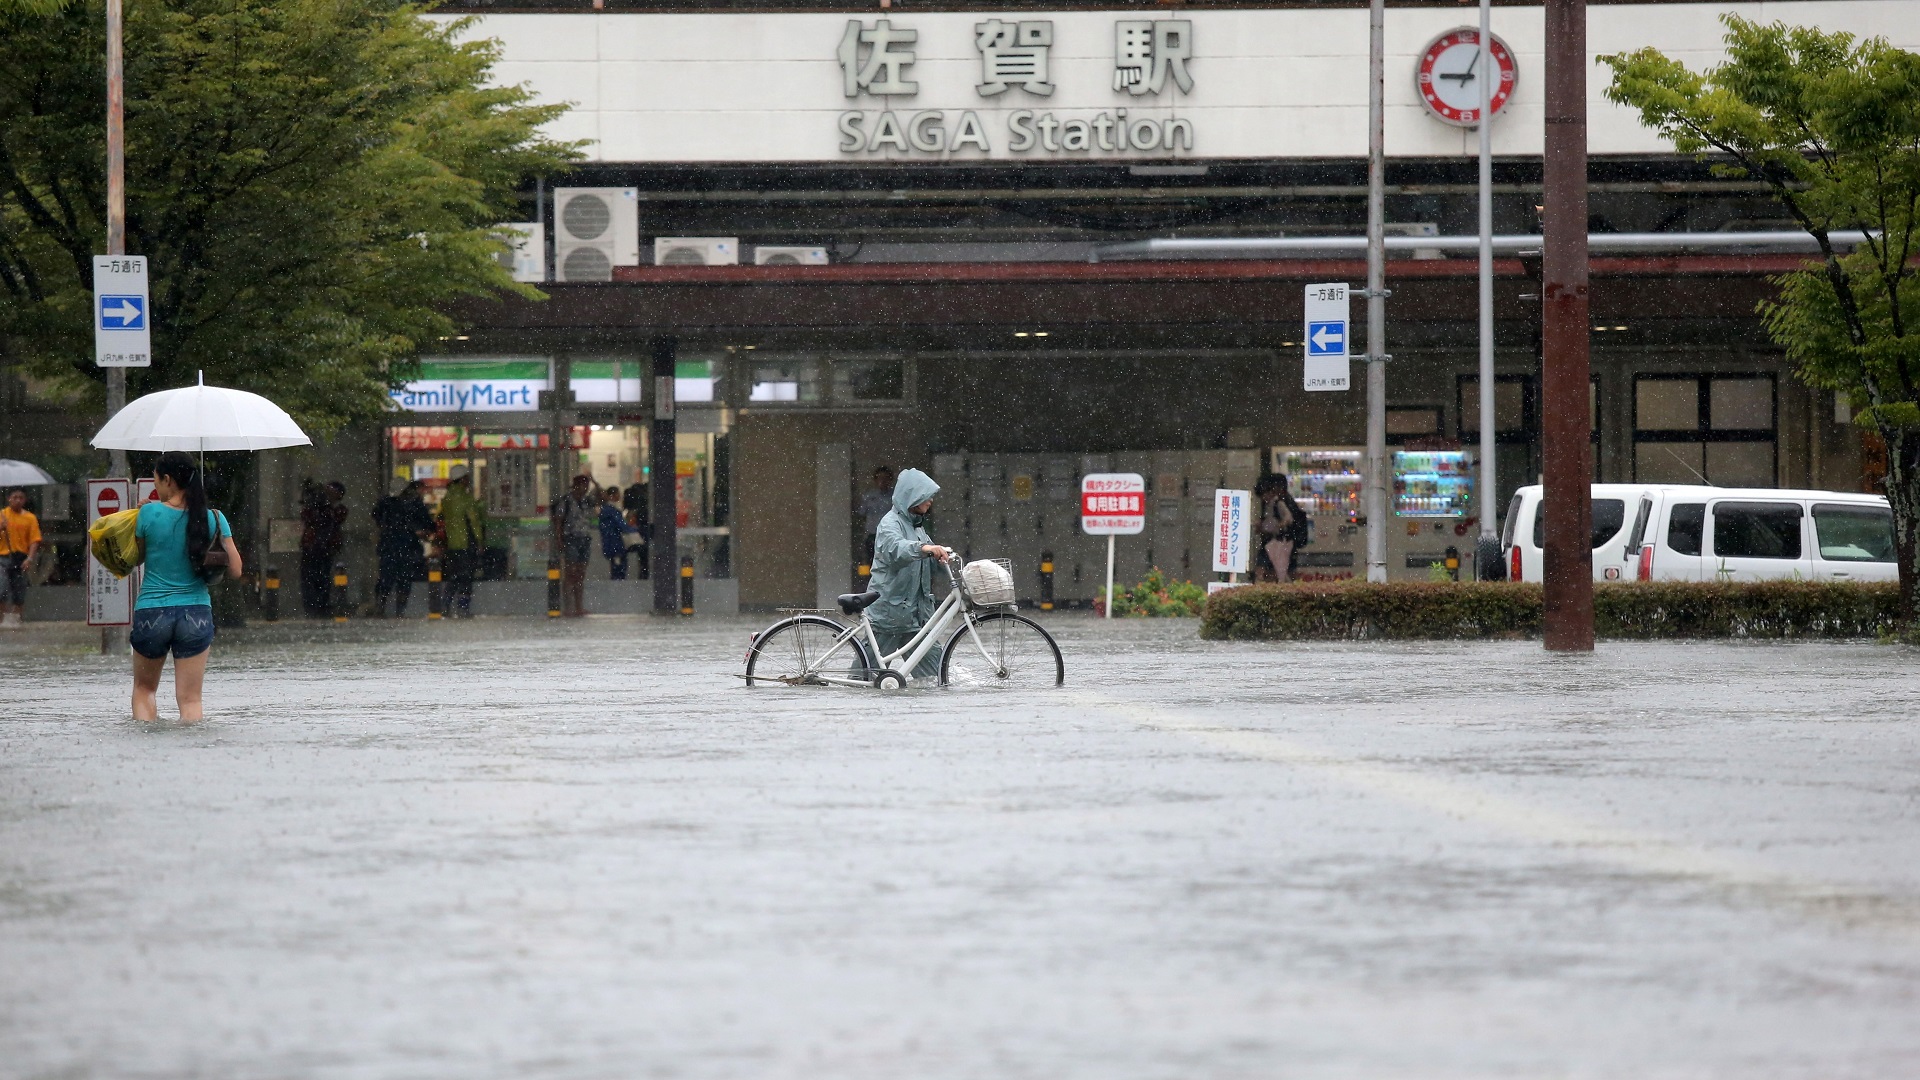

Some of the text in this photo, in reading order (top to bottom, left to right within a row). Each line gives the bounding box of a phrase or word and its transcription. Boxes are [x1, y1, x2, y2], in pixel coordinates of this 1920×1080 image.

[836, 18, 1195, 98] 佐賀駅
[838, 107, 1194, 152] SAGA Station
[100, 260, 142, 273] 一方通行
[1309, 288, 1344, 301] 一方通行
[1086, 480, 1141, 491] 構内タクシー
[1086, 496, 1140, 513] 専用駐車場
[1219, 496, 1230, 566] 専用駐車場
[1230, 496, 1240, 567] 構内タクシー
